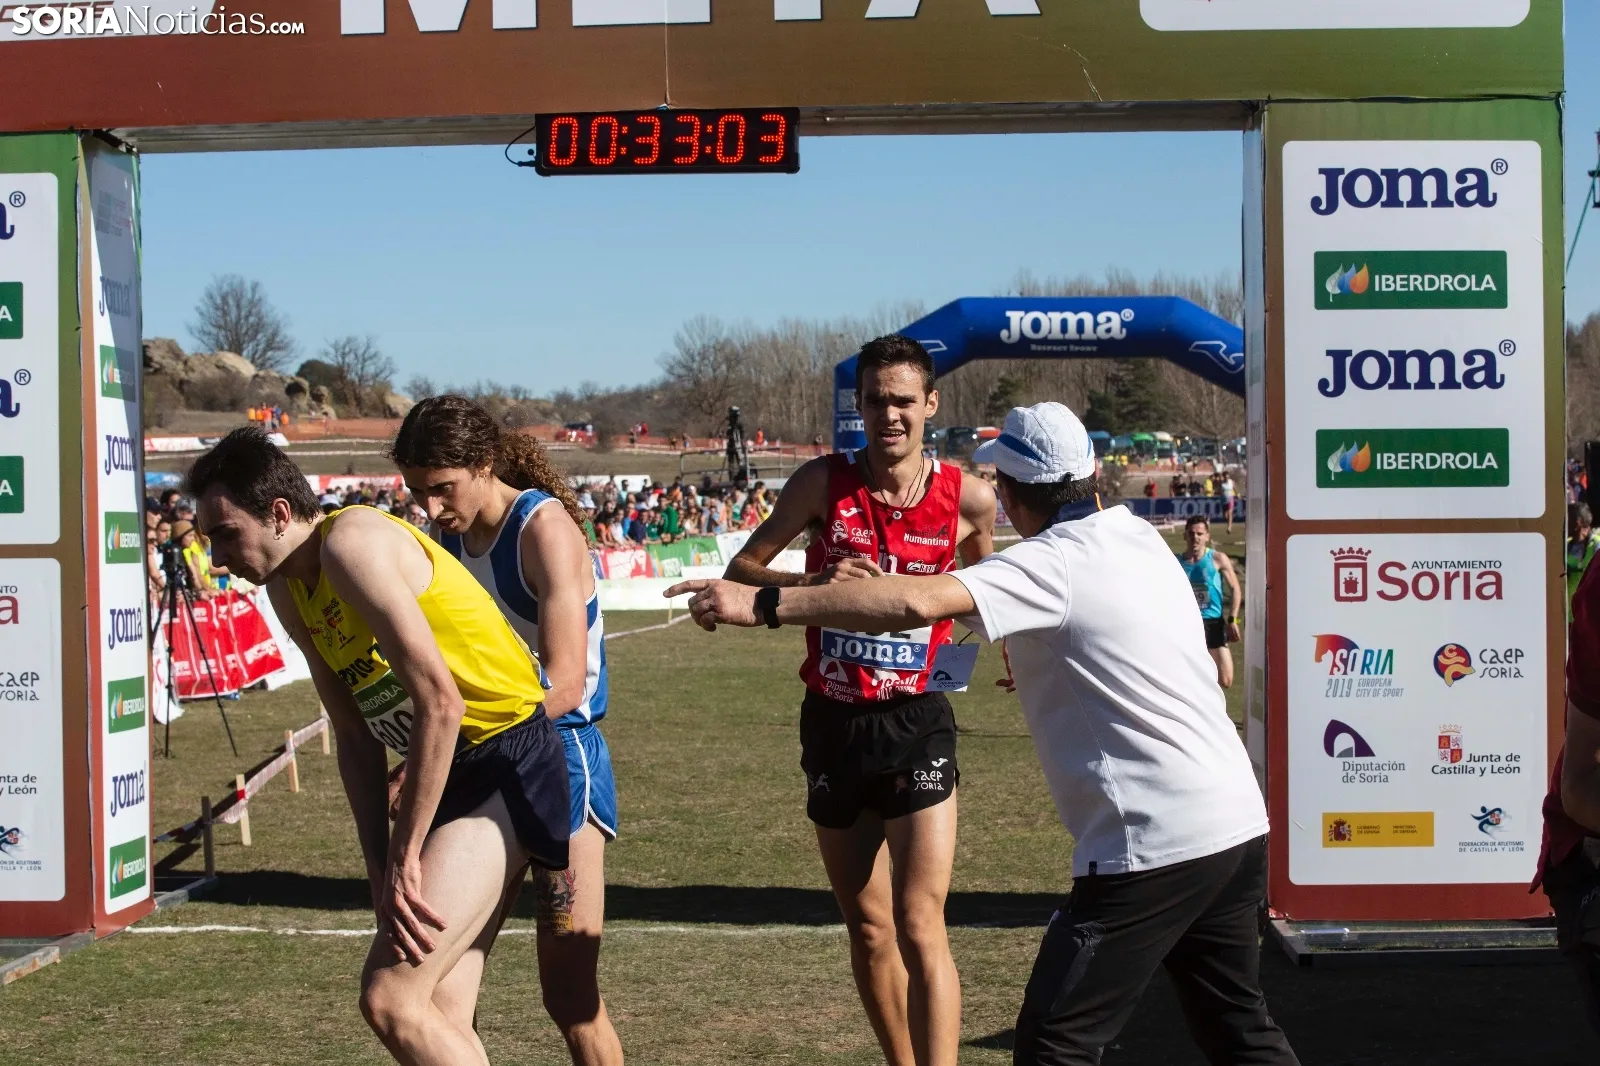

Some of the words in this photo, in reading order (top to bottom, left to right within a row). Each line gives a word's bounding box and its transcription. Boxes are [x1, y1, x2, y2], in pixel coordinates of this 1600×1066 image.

[1374, 274, 1497, 292] IBERDROLA
[1376, 452, 1498, 470] IBERDROLA
[903, 533, 949, 547] Numantino
[1411, 560, 1502, 569] AYUNTAMIENTO
[1376, 560, 1503, 602] Soria
[108, 607, 143, 650] Joma
[1325, 678, 1353, 698] 2019
[1357, 678, 1392, 688] EUROPEAN
[1356, 688, 1371, 698] CITY
[1372, 688, 1381, 698] OF
[1382, 687, 1404, 698] SPORT
[1466, 752, 1502, 763] Junta
[1505, 752, 1521, 763] de
[1342, 760, 1405, 773] Diputación
[1431, 764, 1475, 775] Castilla
[1478, 766, 1485, 777] y
[1491, 763, 1521, 775] León
[22, 773, 37, 783] de
[1342, 773, 1356, 783] de
[1359, 773, 1389, 783] Soria
[8, 785, 37, 795] León
[110, 769, 145, 817] Joma
